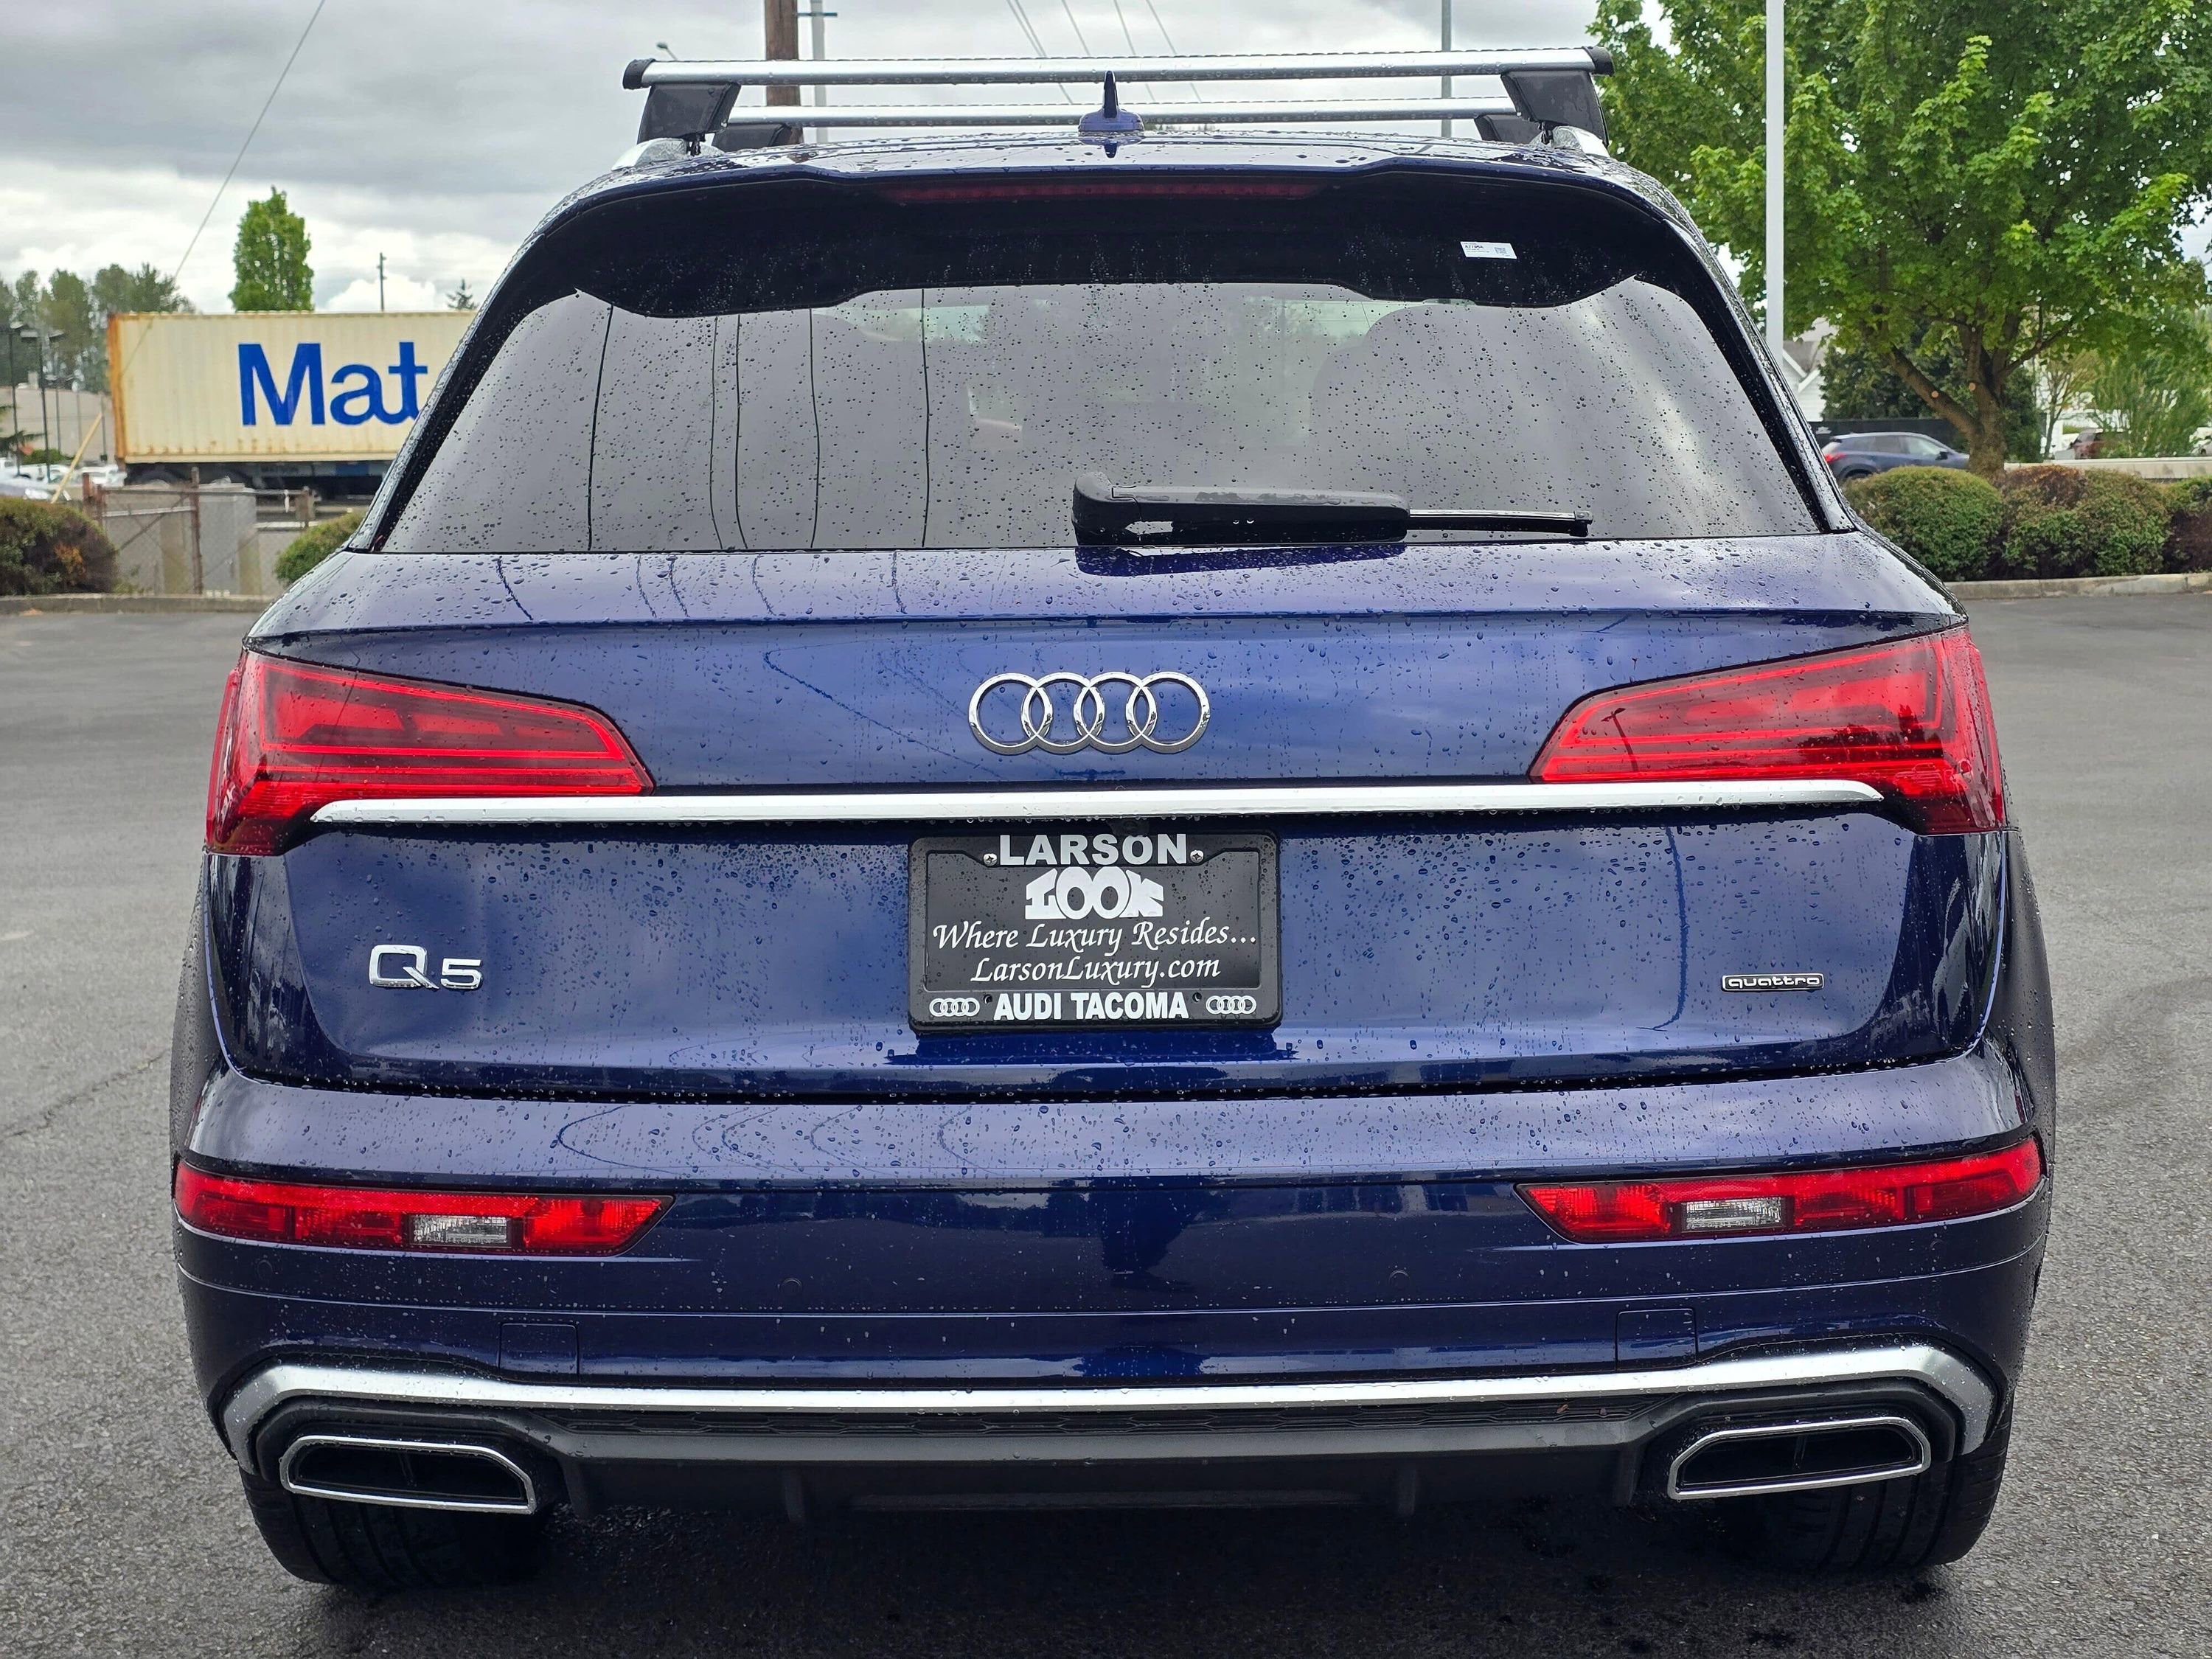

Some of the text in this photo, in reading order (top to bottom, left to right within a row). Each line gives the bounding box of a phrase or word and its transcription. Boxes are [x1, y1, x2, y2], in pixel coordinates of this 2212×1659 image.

[1000, 833, 1187, 866] LARSON
[1025, 866, 1164, 919] LOOK
[933, 916, 1256, 957] Where Luxury Resides...
[369, 945, 484, 990] Q5
[970, 956, 1221, 988] LarsonLuxury.com
[1728, 975, 1820, 989] quattro
[993, 992, 1189, 1020] AUDI TACOMA
